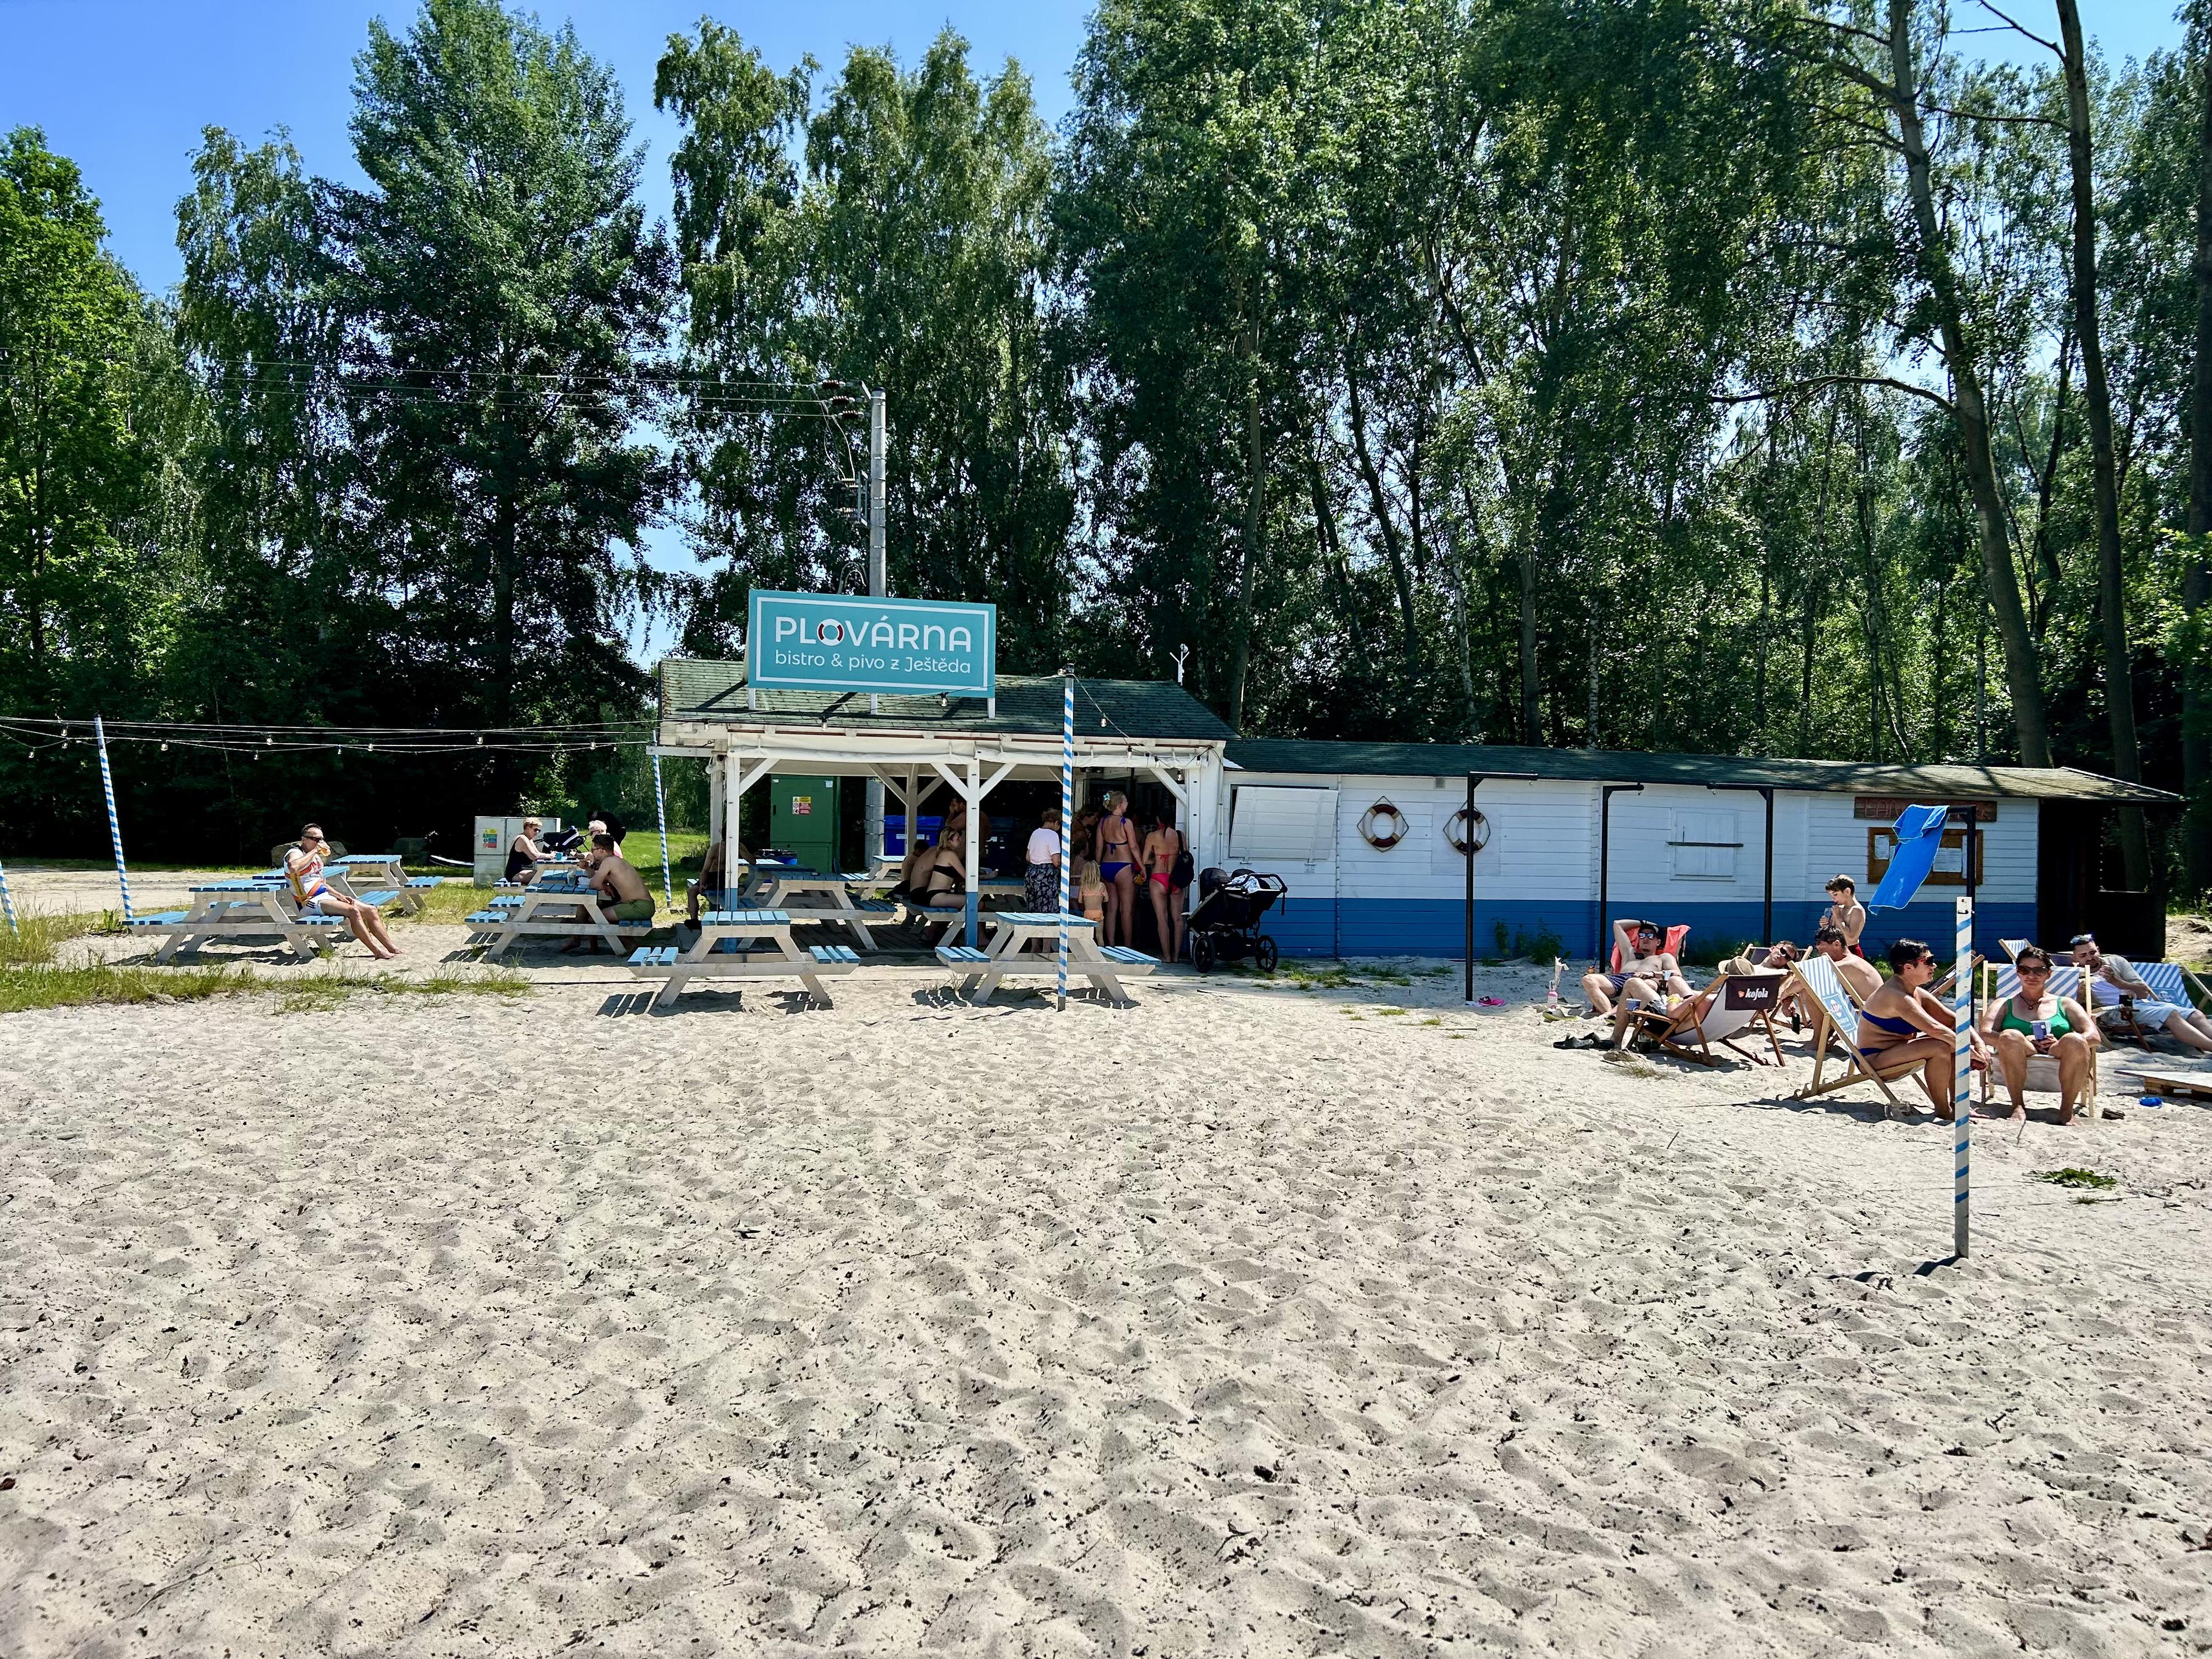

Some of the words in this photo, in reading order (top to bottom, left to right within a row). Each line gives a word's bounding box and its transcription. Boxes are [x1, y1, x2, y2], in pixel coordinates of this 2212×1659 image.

[775, 649, 825, 666] bistro
[831, 653, 843, 667] &
[849, 654, 885, 671] pivo
[890, 659, 900, 670] z
[904, 656, 971, 674] Ještěda
[1745, 988, 1768, 1001] kofola
